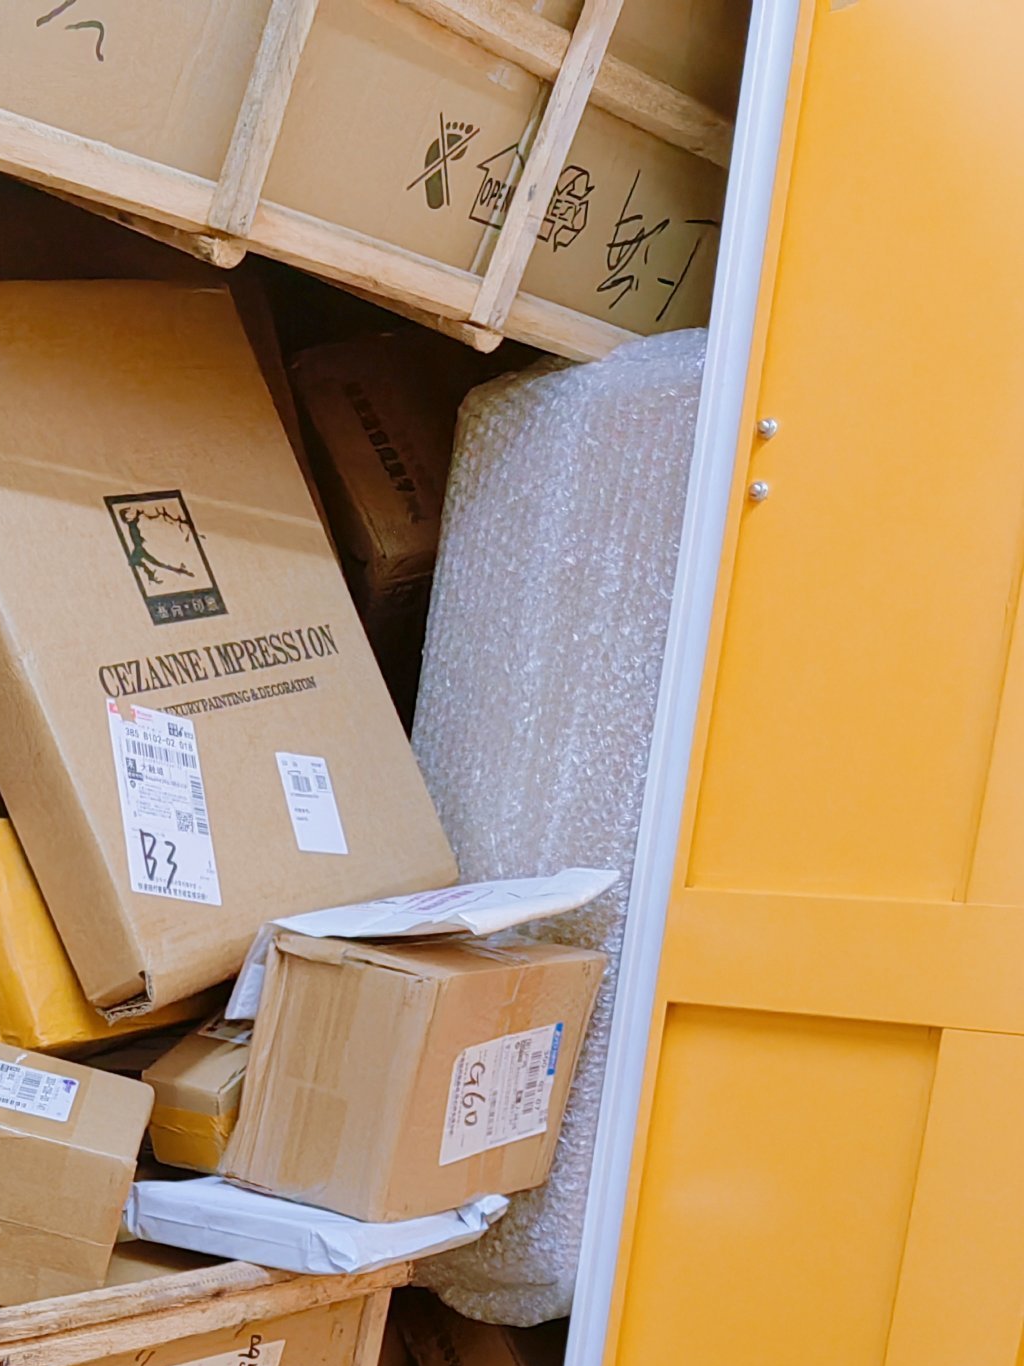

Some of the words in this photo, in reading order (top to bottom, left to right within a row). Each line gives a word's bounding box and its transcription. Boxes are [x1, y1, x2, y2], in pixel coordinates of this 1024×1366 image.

[98, 649, 209, 698] CEZANNE
[203, 624, 340, 678] IMPRESSION
[139, 828, 178, 889] B3
[462, 1061, 487, 1127] G60
